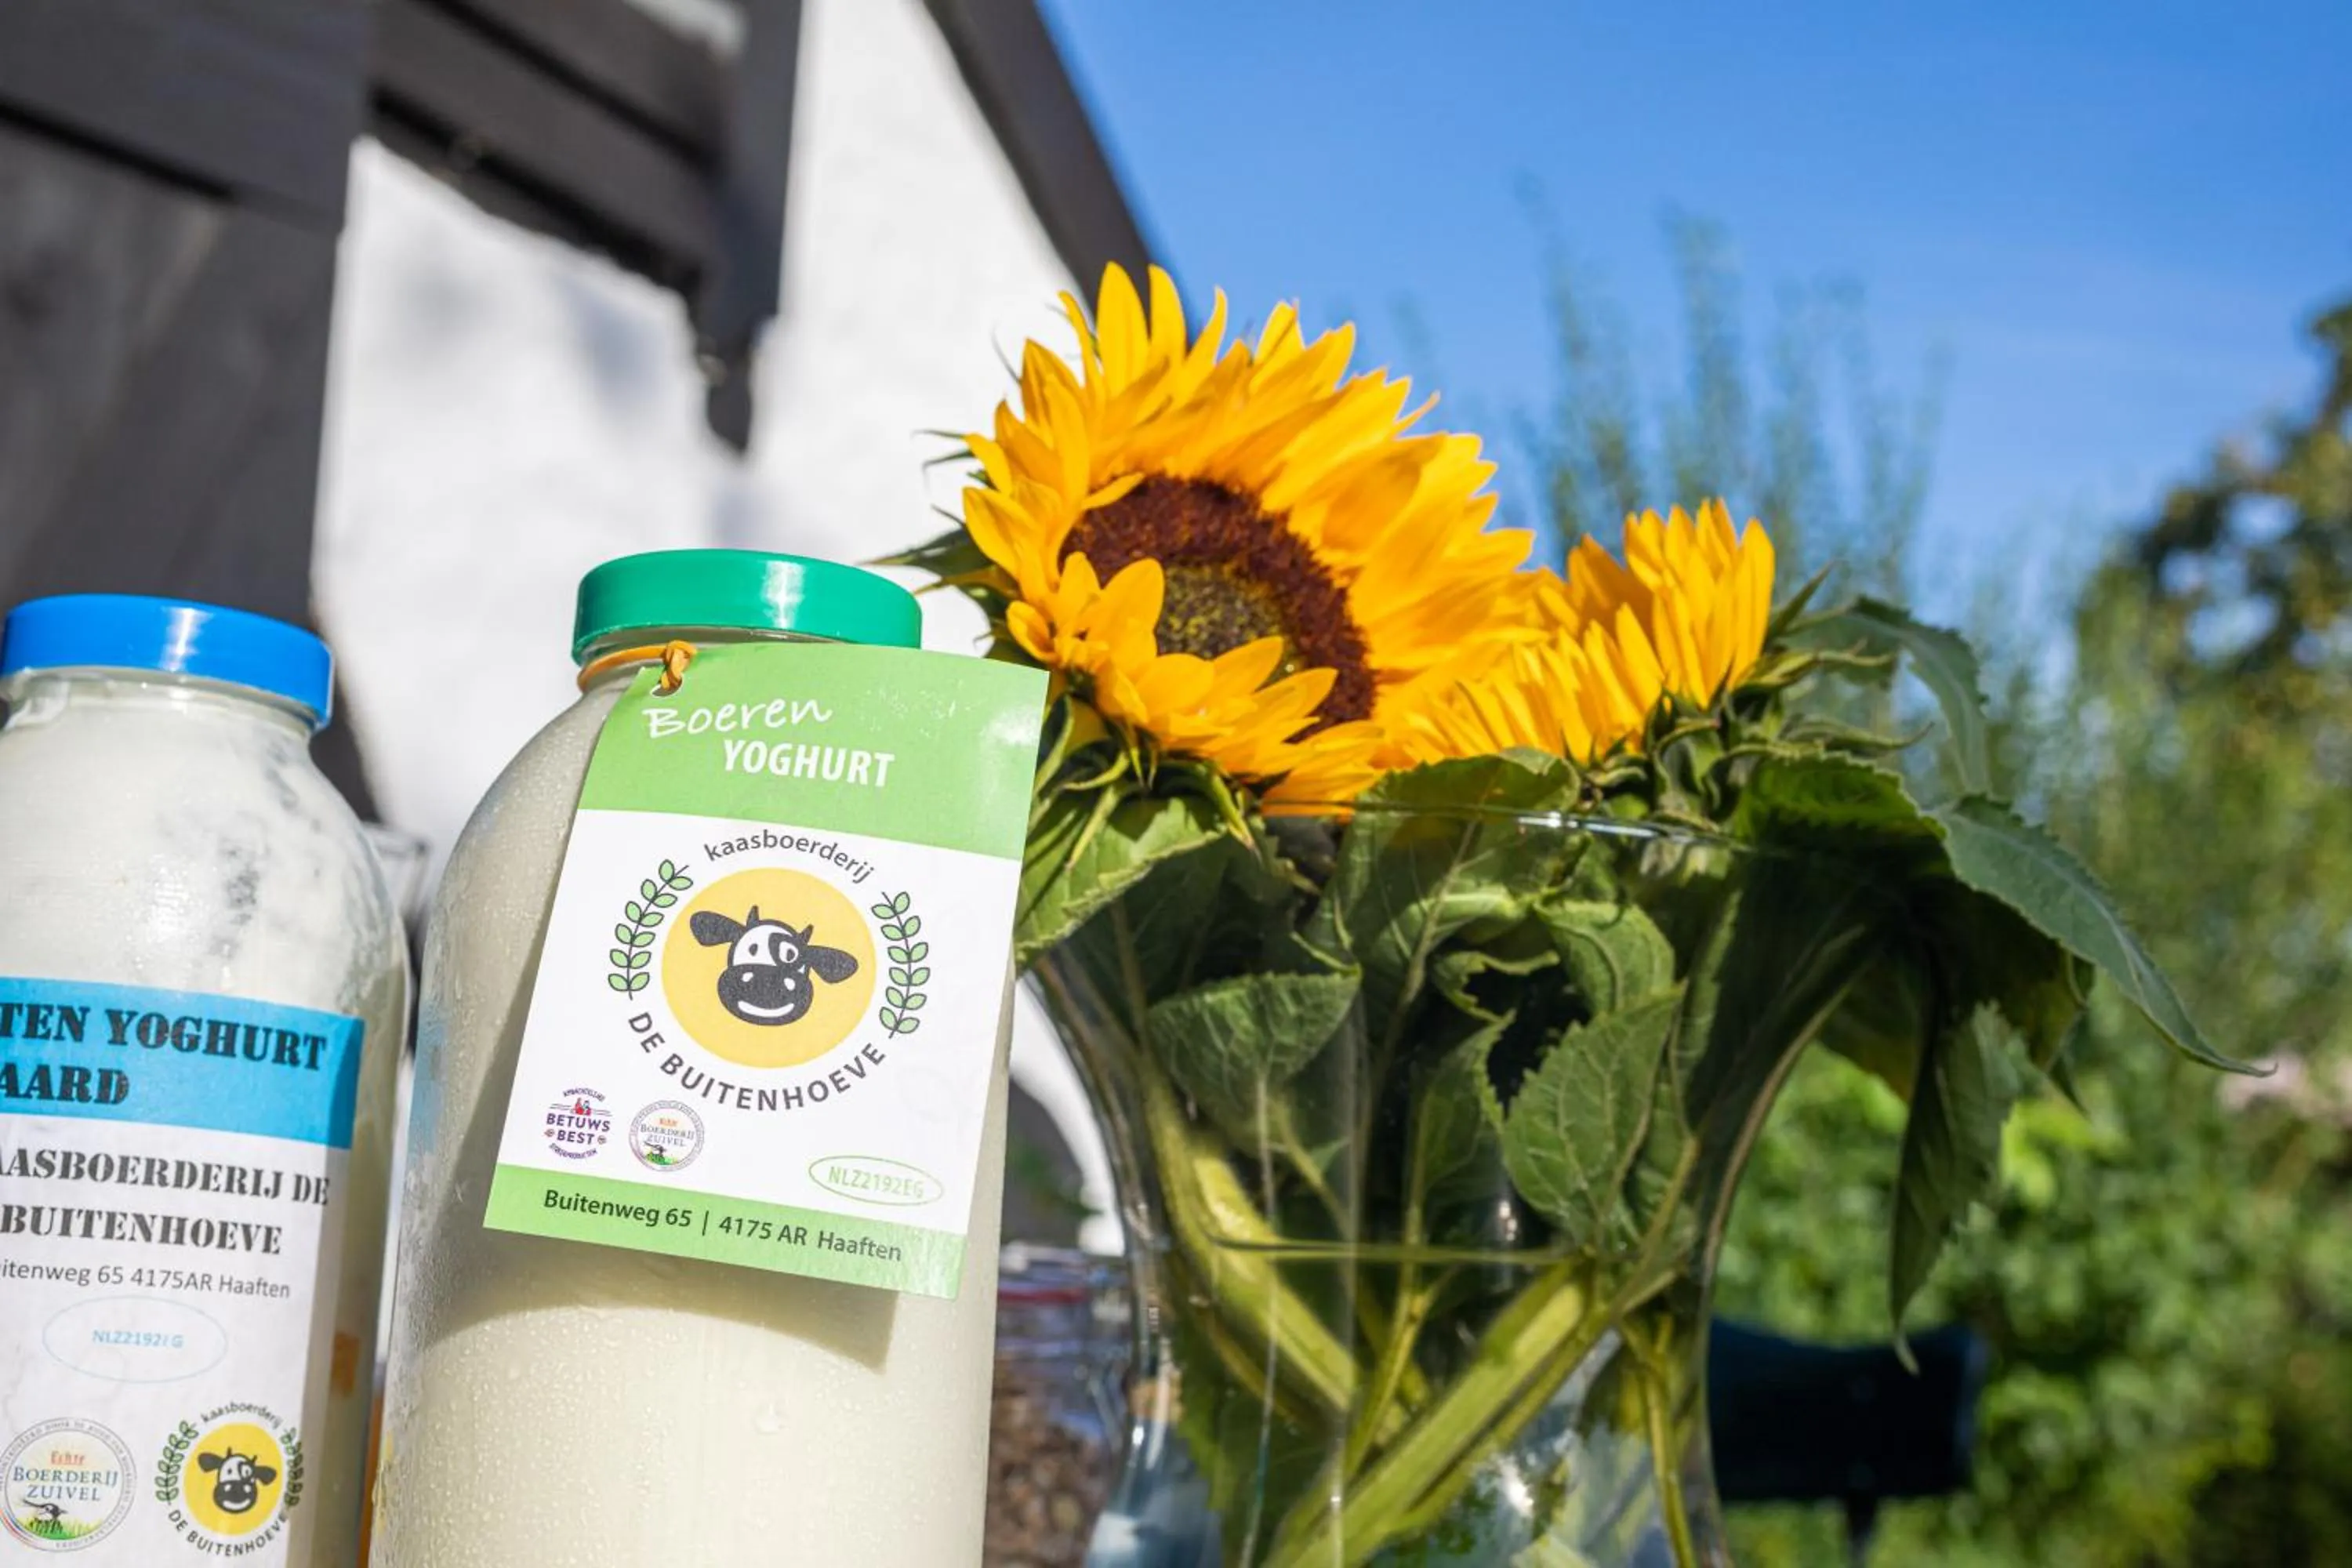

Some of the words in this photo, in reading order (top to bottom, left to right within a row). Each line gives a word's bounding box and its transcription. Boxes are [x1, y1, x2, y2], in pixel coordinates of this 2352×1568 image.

[643, 698, 833, 739] Boeren
[724, 739, 895, 787] YOGHURT
[703, 829, 875, 884] kaasboerderij
[0, 1002, 90, 1043] TEN
[105, 1008, 327, 1070] YOGHURT
[0, 1062, 129, 1105] AARD
[628, 1012, 666, 1053] DE
[660, 1043, 886, 1111] BUITENHOEVE
[546, 1113, 611, 1132] BETUWS
[557, 1130, 594, 1145] BEST
[0, 1148, 283, 1200] ASBOERDERIJ
[292, 1174, 330, 1206] DE
[0, 1204, 283, 1254] BUITENHOEVE
[544, 1189, 659, 1227] Buitenweg
[666, 1208, 692, 1228] 65
[719, 1215, 772, 1241] 4175
[777, 1224, 808, 1247] AR
[818, 1230, 902, 1262] Haaften
[0, 1258, 90, 1286] itenweg
[97, 1265, 124, 1285] 65
[131, 1269, 212, 1291] 4175AR
[219, 1275, 290, 1298] Haaften
[13, 1466, 118, 1488] BOERDERIJ
[27, 1485, 100, 1501] ZUIVEL
[169, 1509, 188, 1532] DE
[187, 1512, 288, 1557] BUITENHOEVE
